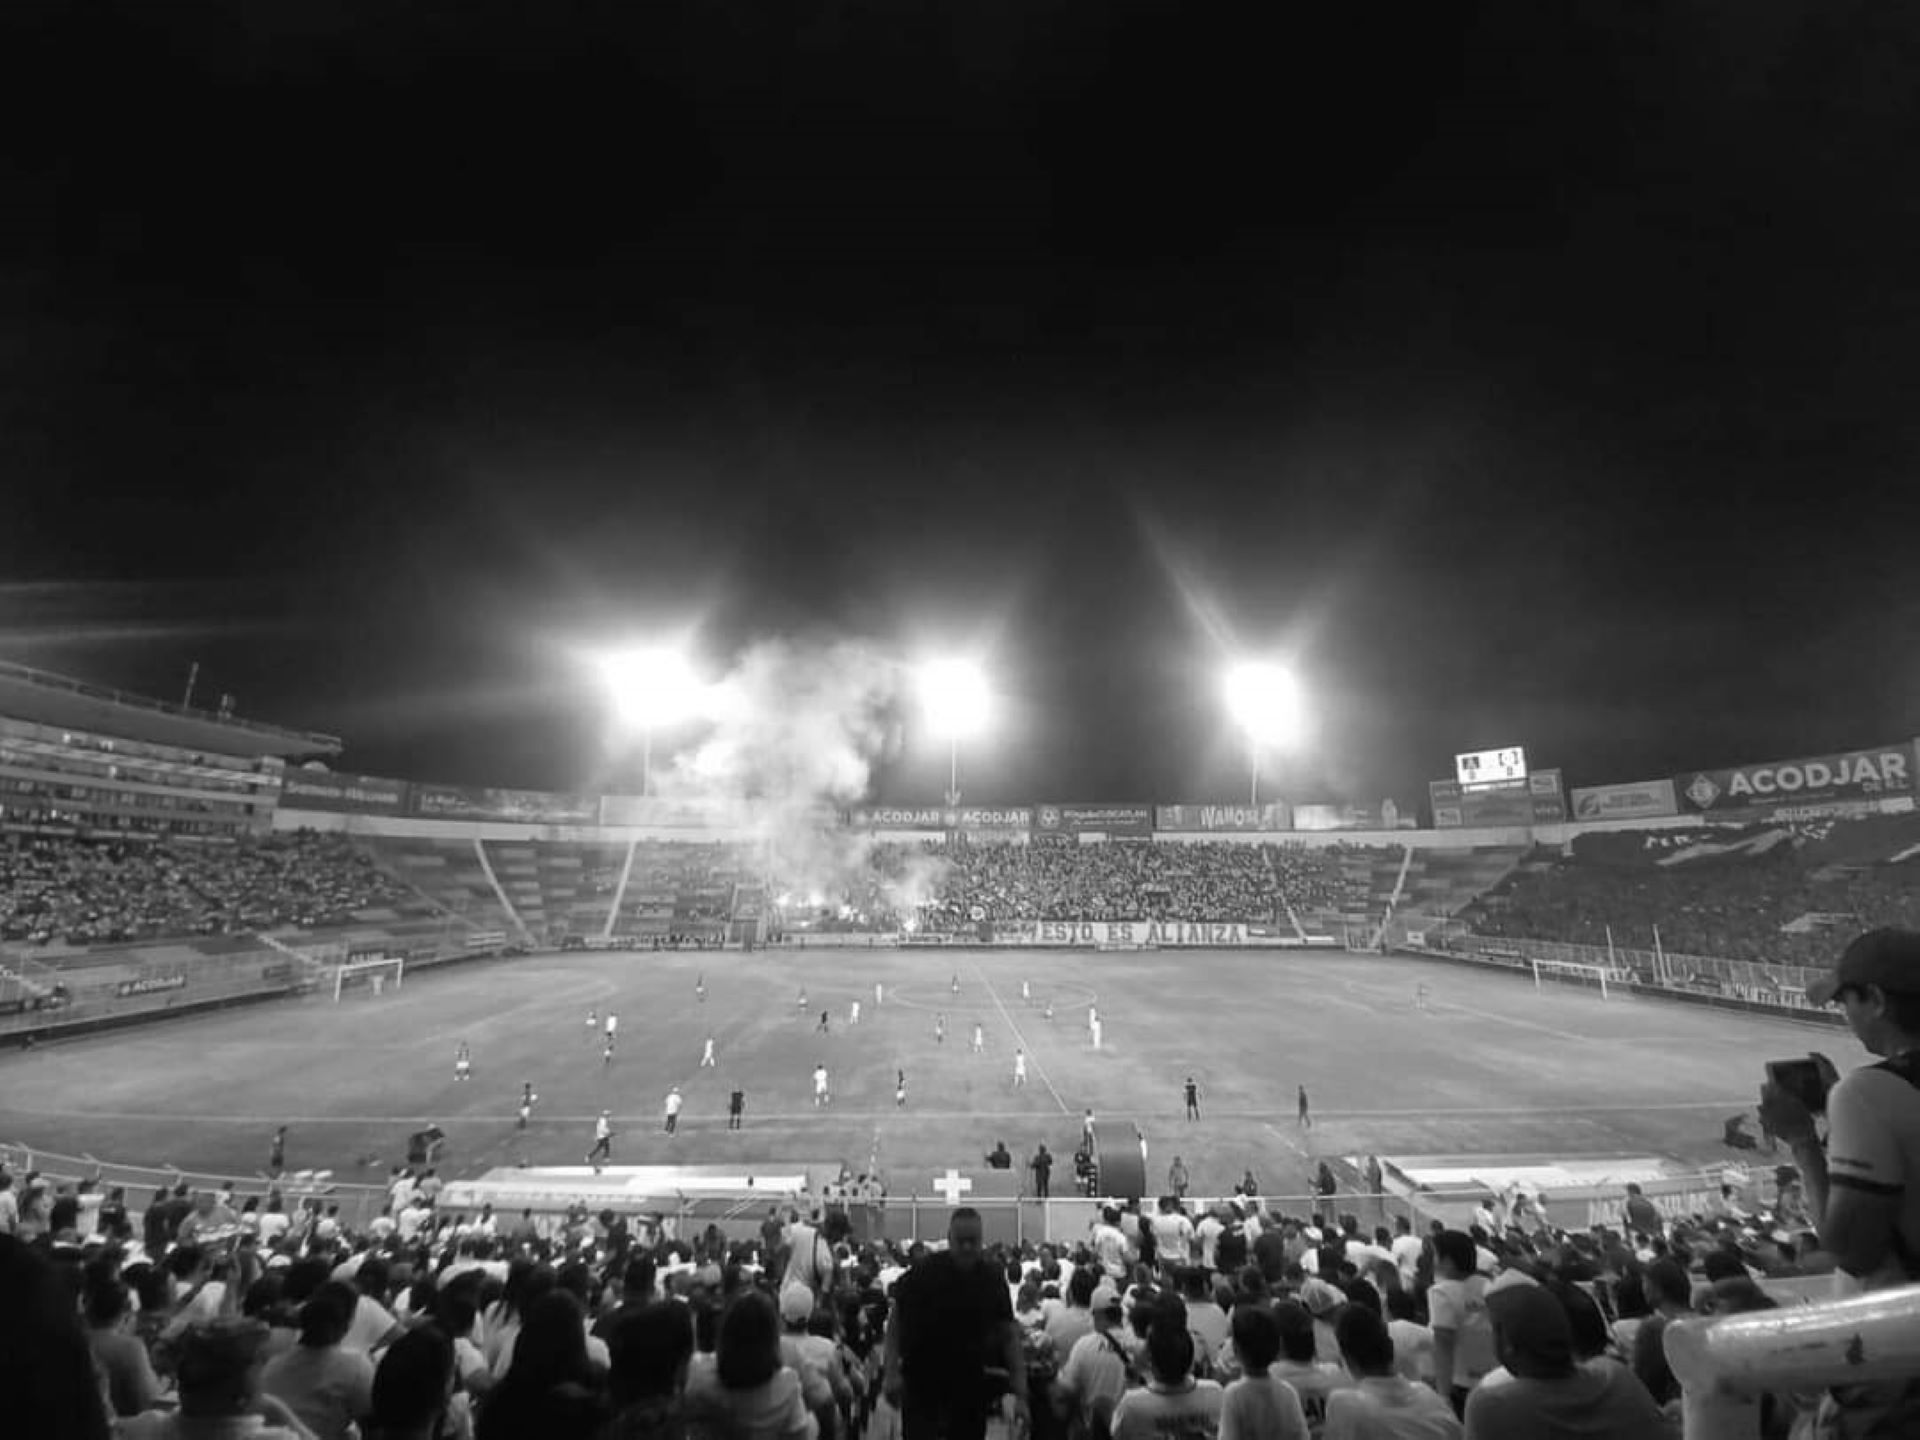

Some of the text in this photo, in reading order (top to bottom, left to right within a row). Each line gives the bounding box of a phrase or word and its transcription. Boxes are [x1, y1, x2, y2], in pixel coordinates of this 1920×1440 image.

[1728, 752, 1908, 796] ACODJAR
[872, 810, 940, 825] ACODJAR
[962, 810, 1030, 825] ACODJAR
[1040, 922, 1242, 943] ESTO ES ALIANZA
